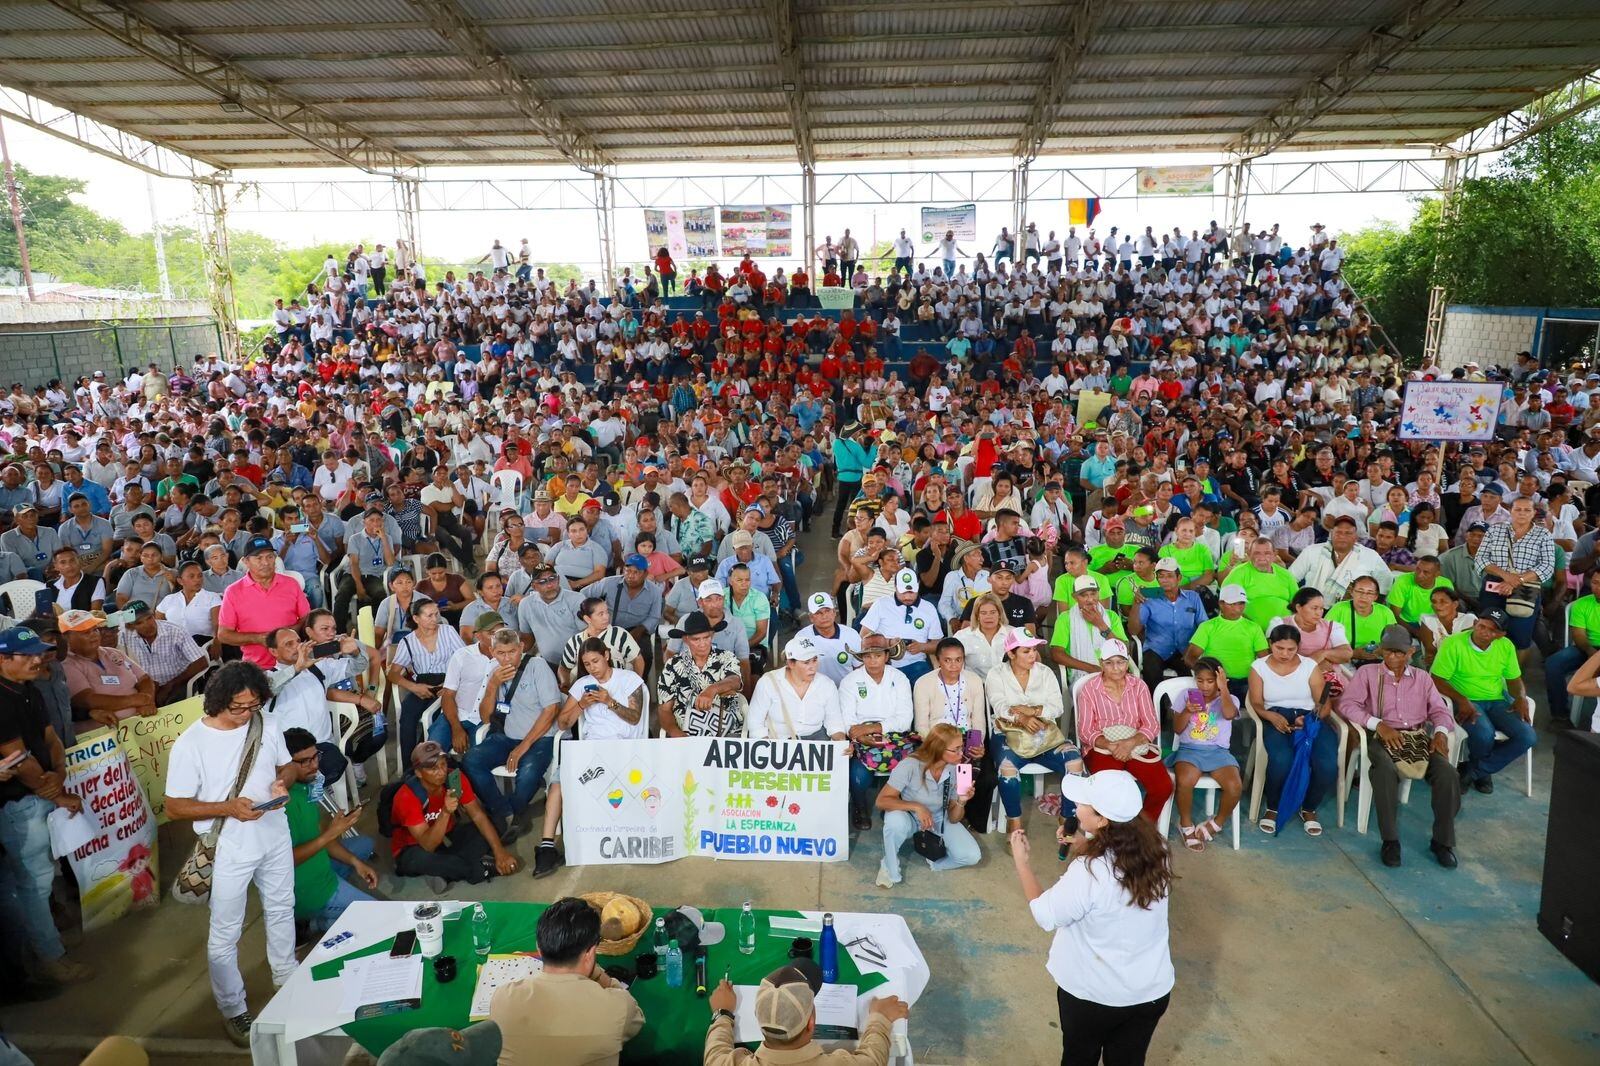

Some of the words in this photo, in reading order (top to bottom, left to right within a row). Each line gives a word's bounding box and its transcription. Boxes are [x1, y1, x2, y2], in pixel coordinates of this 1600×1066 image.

[64, 737, 117, 767] TRICIA
[703, 739, 835, 772] ARIGUANI
[63, 774, 101, 800] ujer
[103, 762, 123, 786] del
[728, 769, 832, 792] PRESENTE
[90, 781, 137, 814] decidid
[721, 808, 762, 818] ASOCIACION
[726, 819, 737, 830] LA
[741, 819, 797, 832] ESPERANZA
[599, 836, 675, 859] CARIBE
[700, 830, 773, 855] PUEBLO
[776, 836, 838, 857] NUEVO
